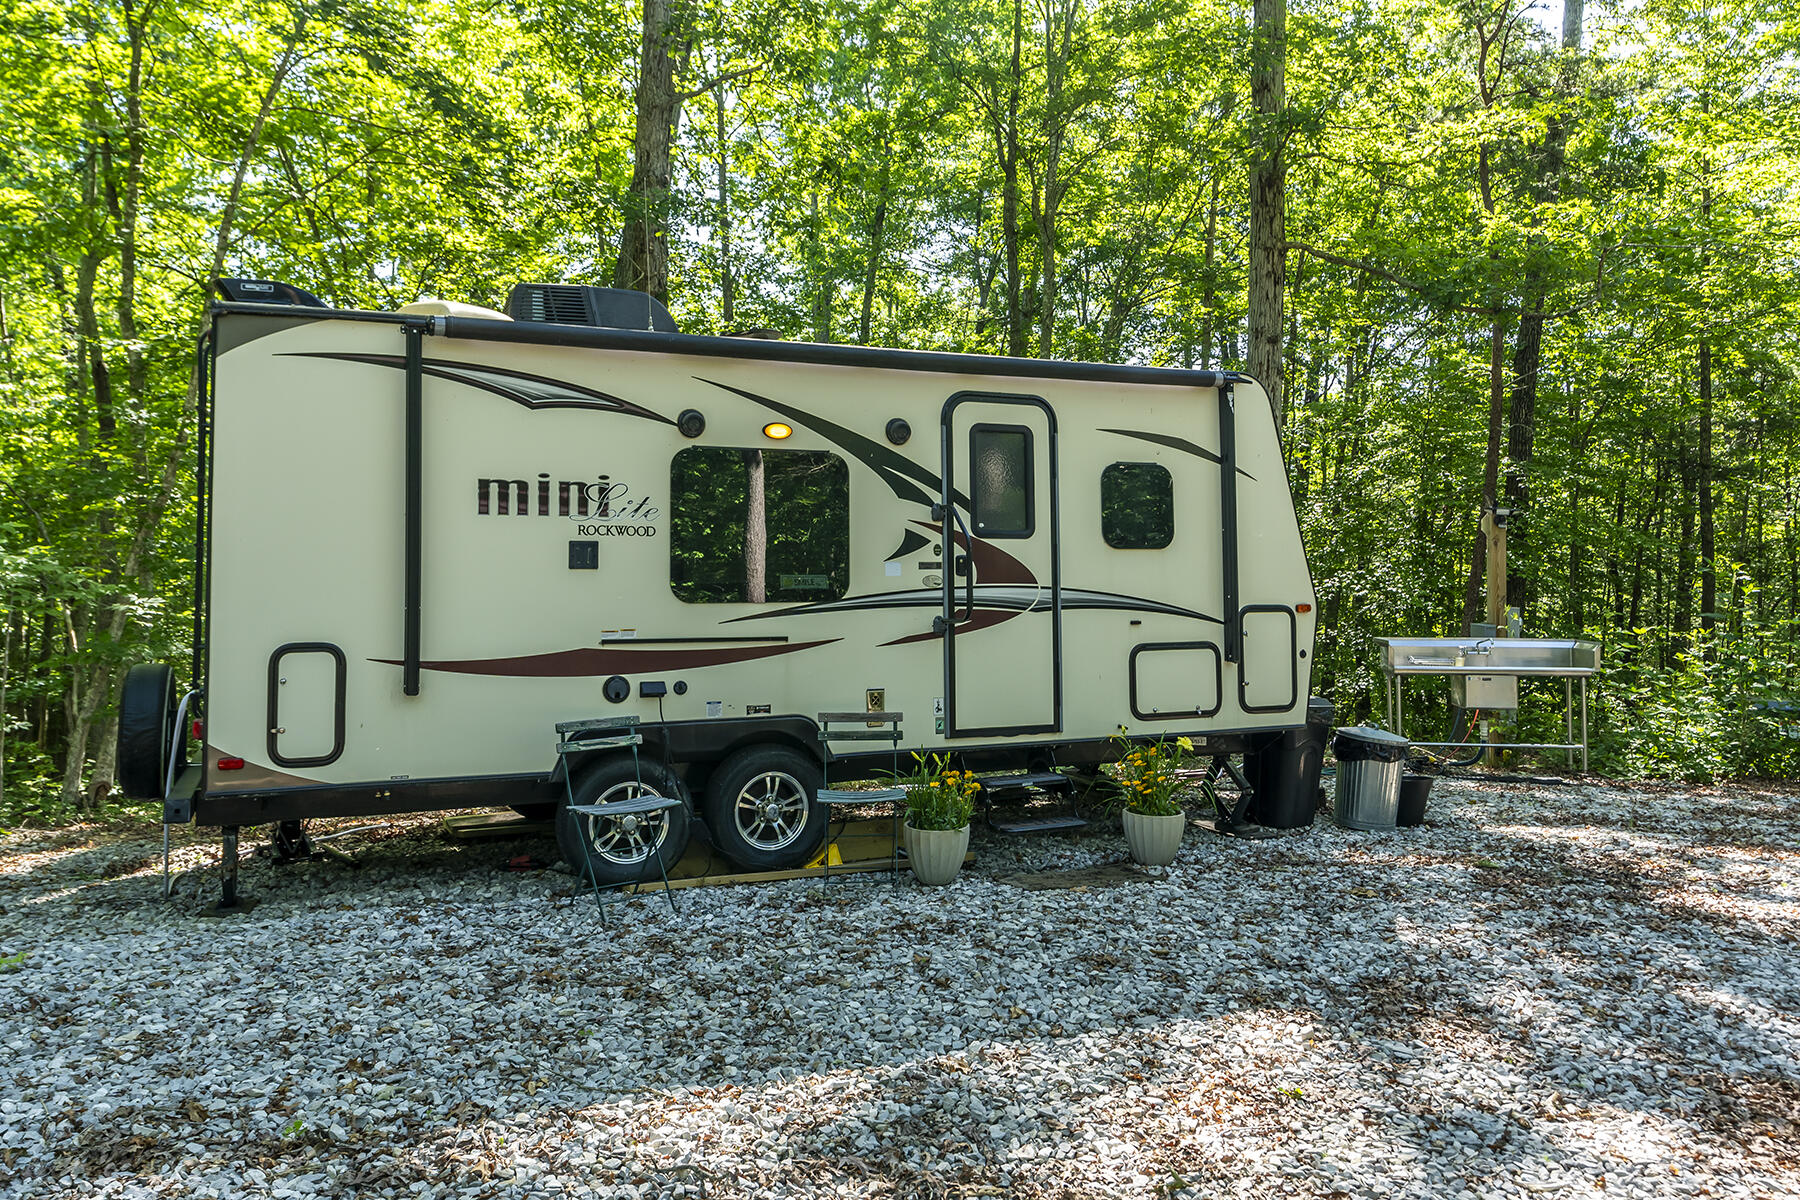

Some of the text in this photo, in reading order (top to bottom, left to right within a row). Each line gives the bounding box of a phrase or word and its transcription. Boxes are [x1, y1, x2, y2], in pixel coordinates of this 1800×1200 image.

[478, 473, 661, 521] mini Lite
[577, 524, 656, 537] ROCKWOOD
